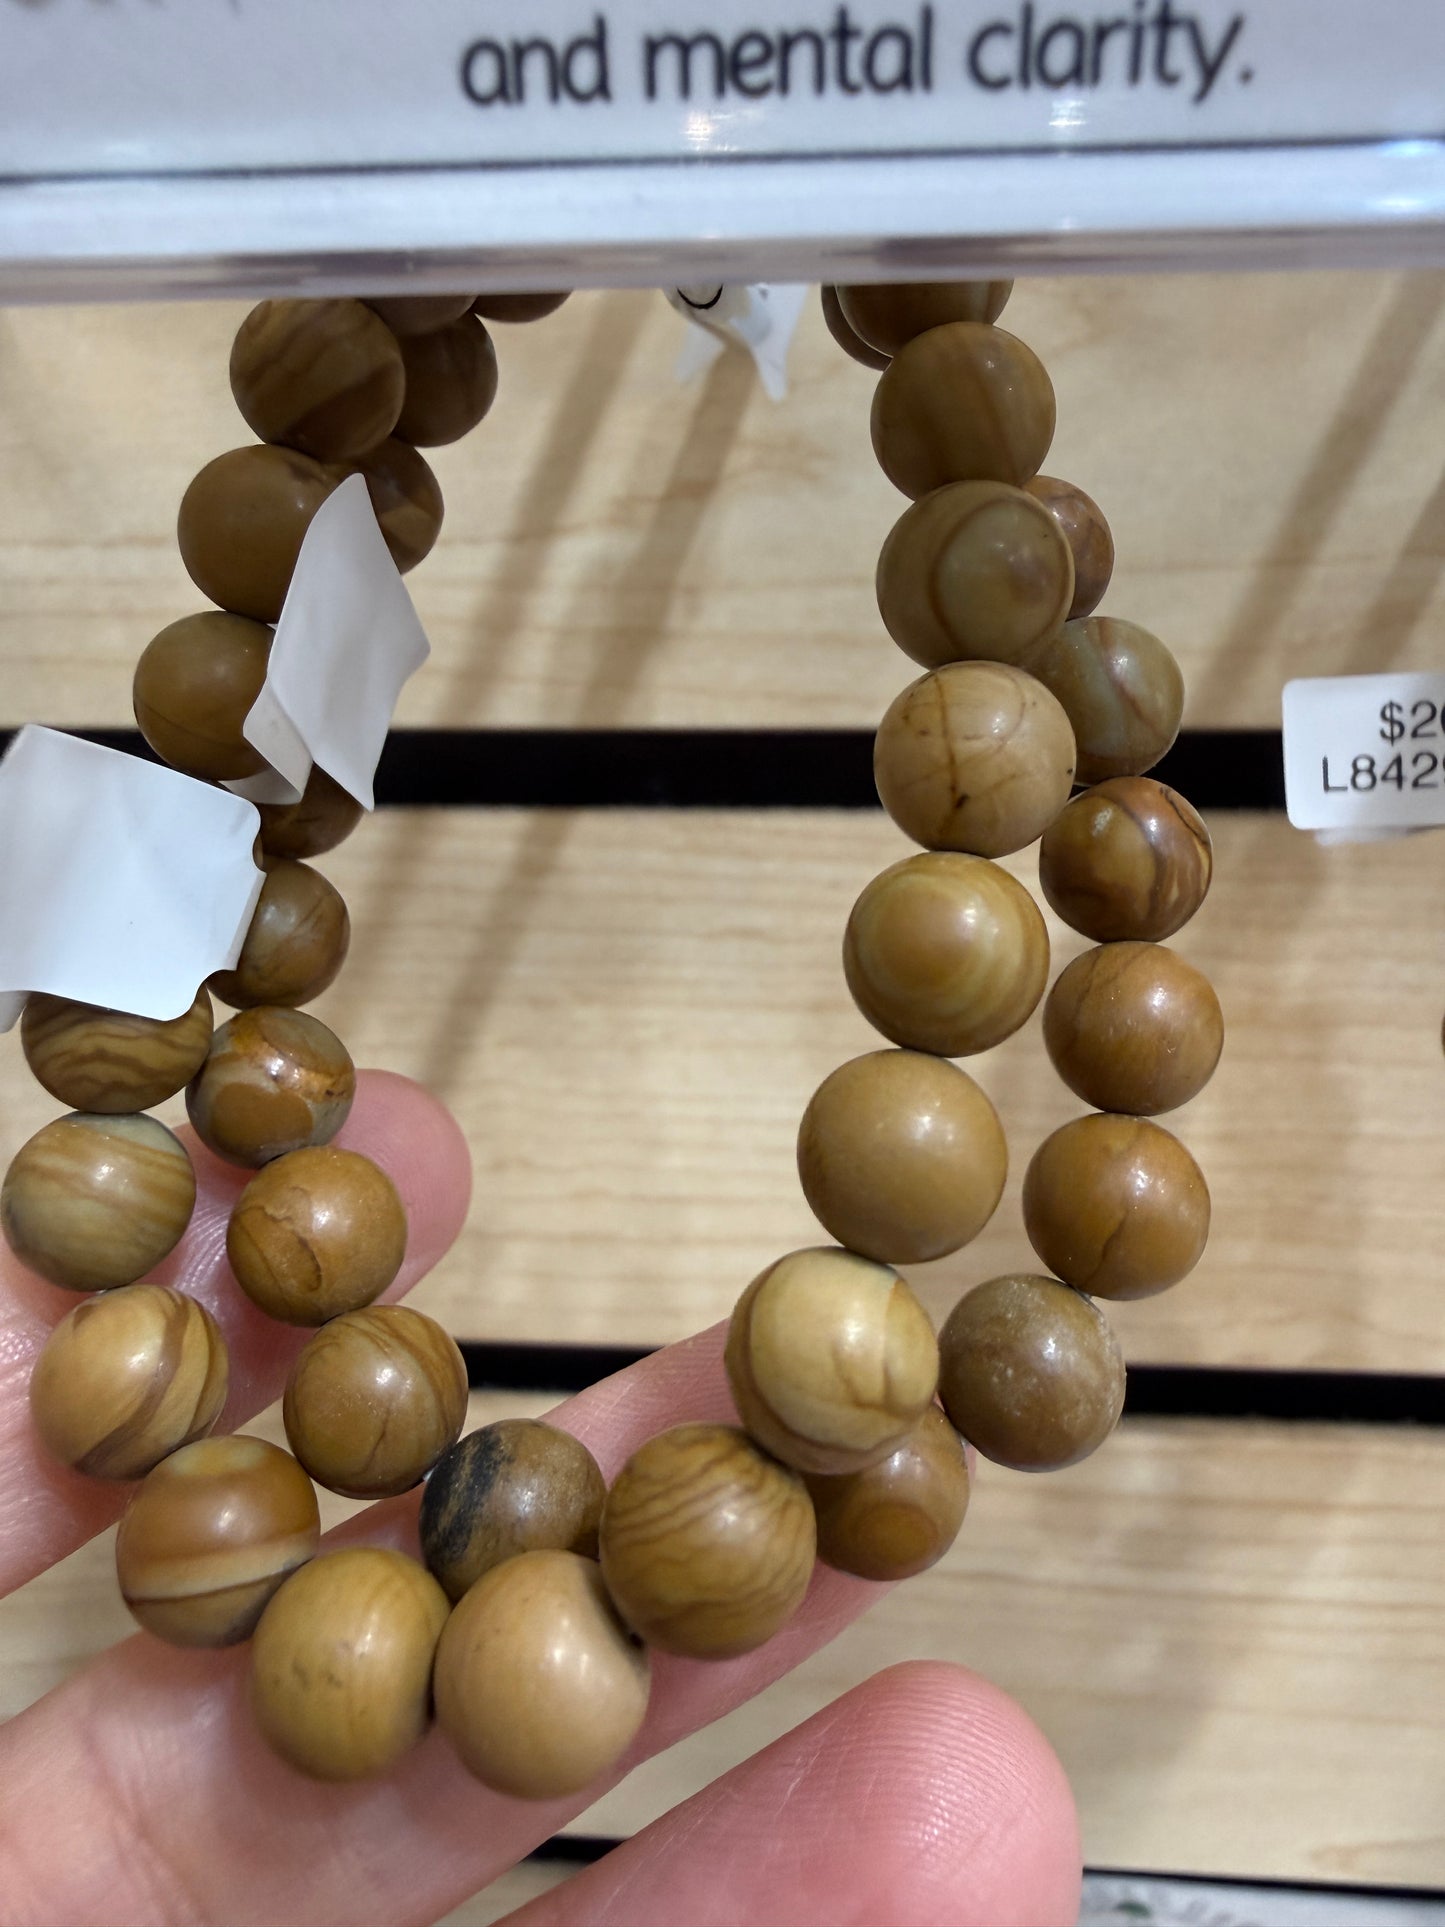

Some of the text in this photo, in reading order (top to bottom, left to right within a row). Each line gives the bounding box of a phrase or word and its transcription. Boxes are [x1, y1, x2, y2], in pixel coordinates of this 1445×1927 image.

[460, 0, 1254, 106] and mental clarity.
[1379, 700, 1445, 747] $2
[1321, 751, 1445, 793] L842
